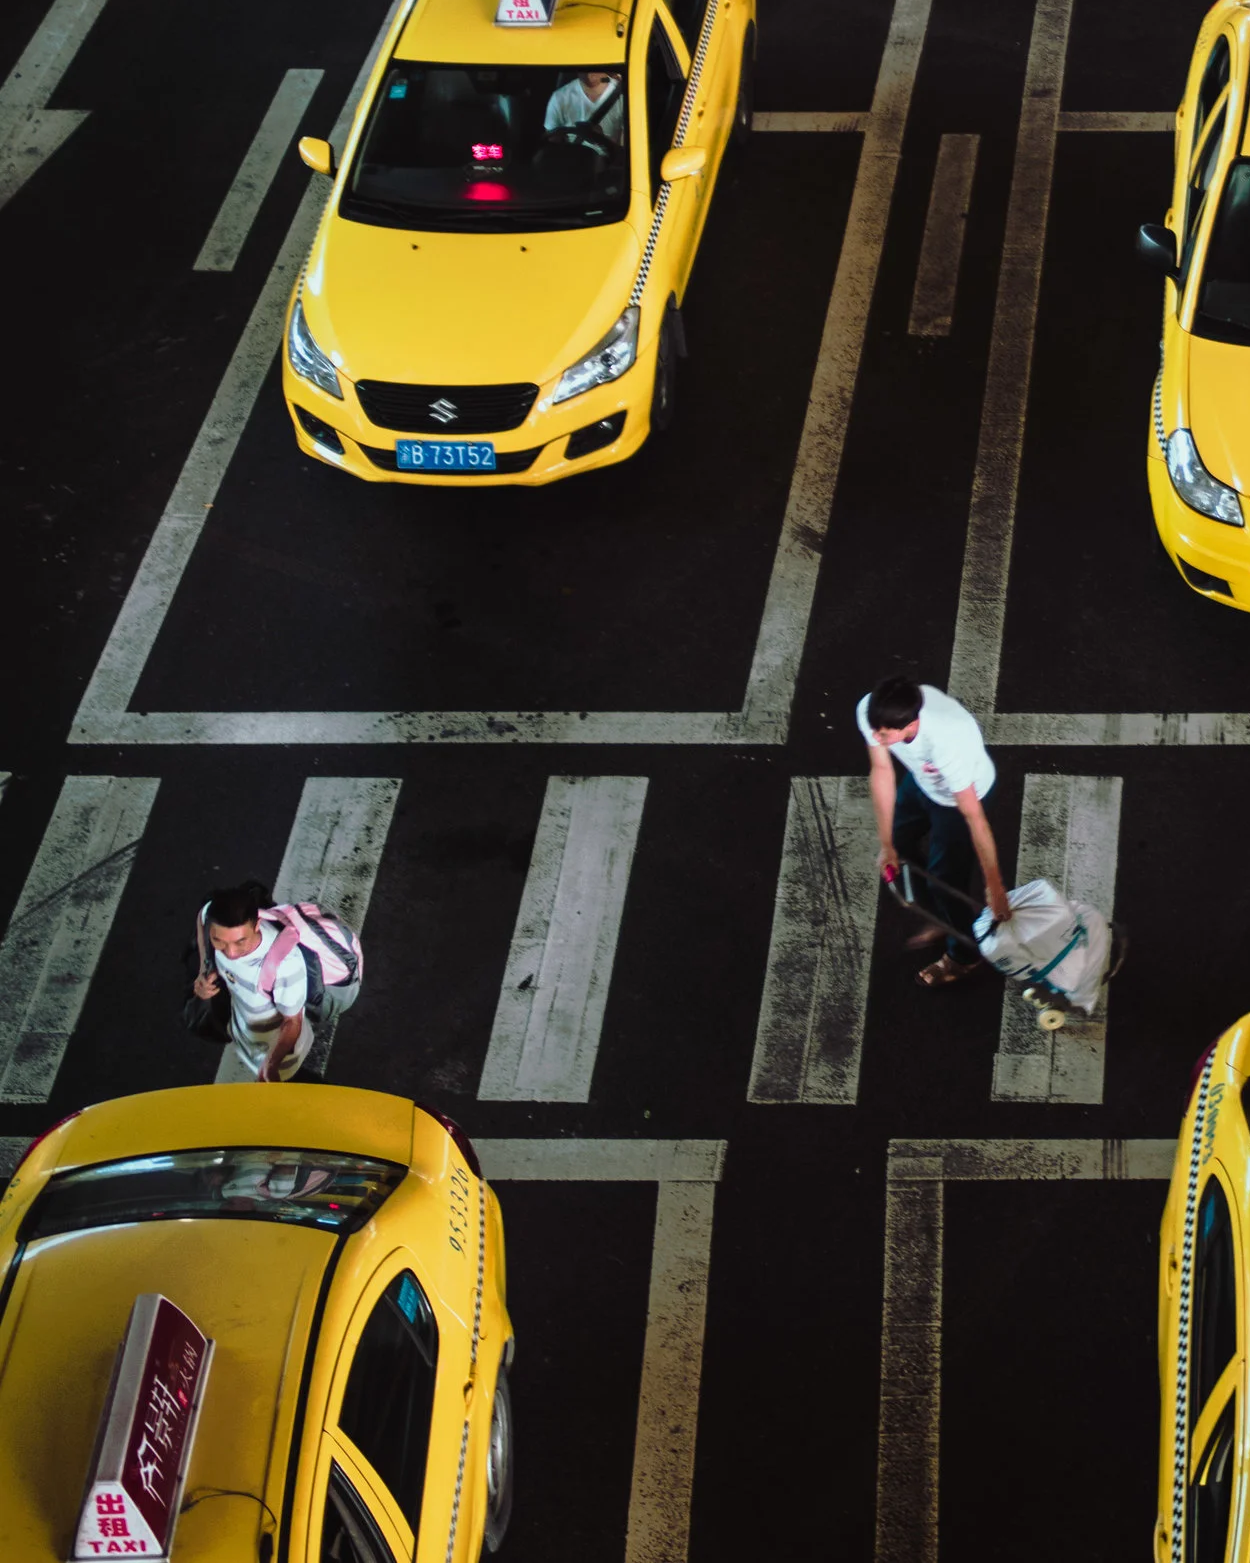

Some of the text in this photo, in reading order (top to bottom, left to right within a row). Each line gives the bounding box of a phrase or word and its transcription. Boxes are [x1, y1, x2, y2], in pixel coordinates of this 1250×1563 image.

[506, 10, 539, 20] TAXI
[448, 1160, 469, 1259] 953326
[96, 1492, 131, 1538] 出租
[88, 1539, 148, 1553] TAXI
